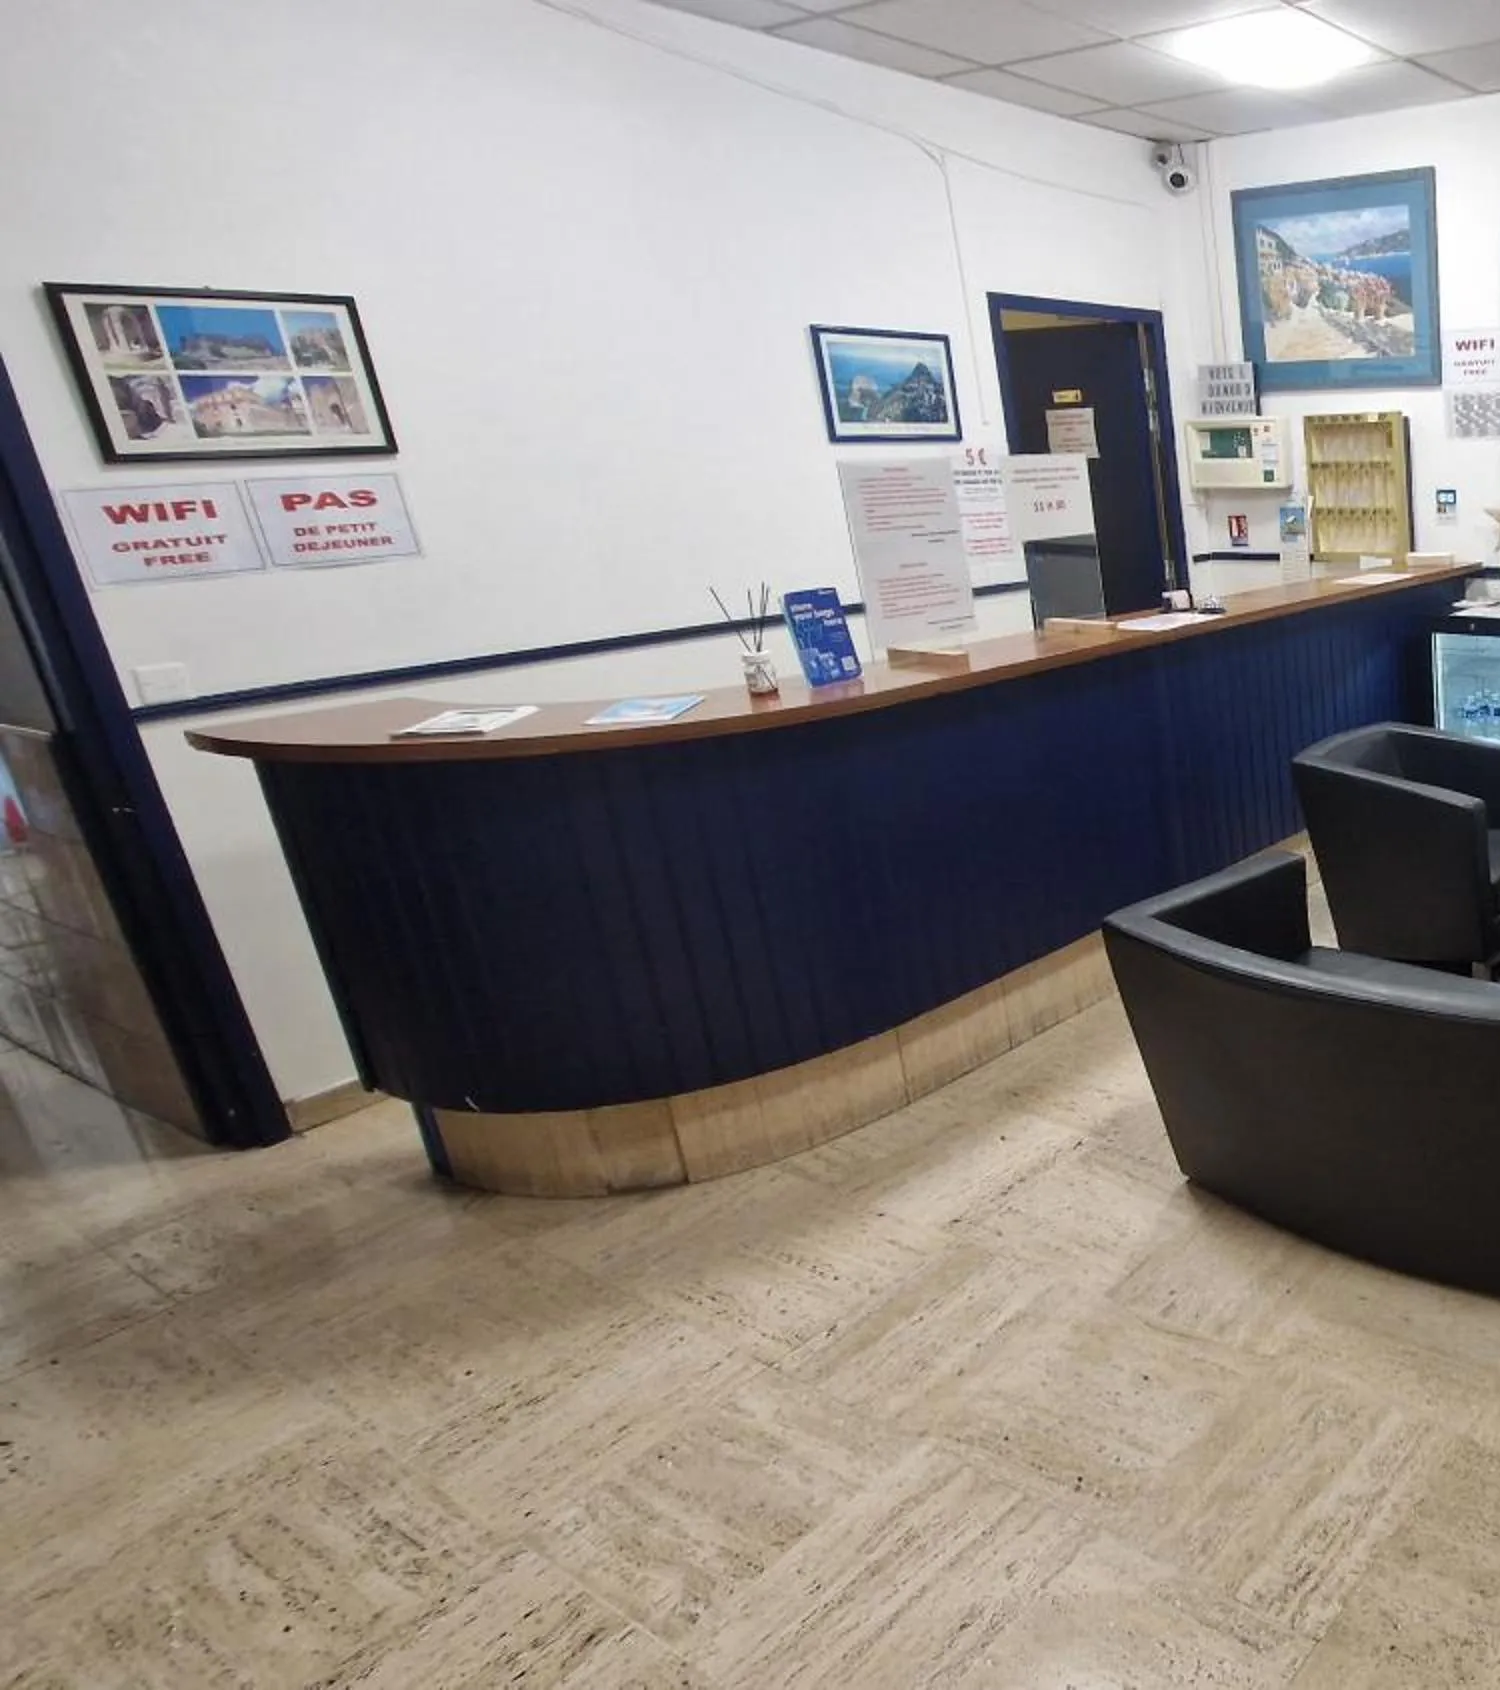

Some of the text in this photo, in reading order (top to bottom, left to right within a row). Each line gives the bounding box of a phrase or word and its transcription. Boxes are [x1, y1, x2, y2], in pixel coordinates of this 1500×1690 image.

[1455, 338, 1495, 351] WIFI
[965, 448, 974, 466] 5
[280, 488, 378, 512] PAS
[101, 499, 219, 525] WIFI
[292, 521, 378, 537] DE PETIT
[111, 533, 228, 553] GRATUIT
[292, 535, 396, 553] DEJEUNER
[144, 551, 213, 567] FREE
